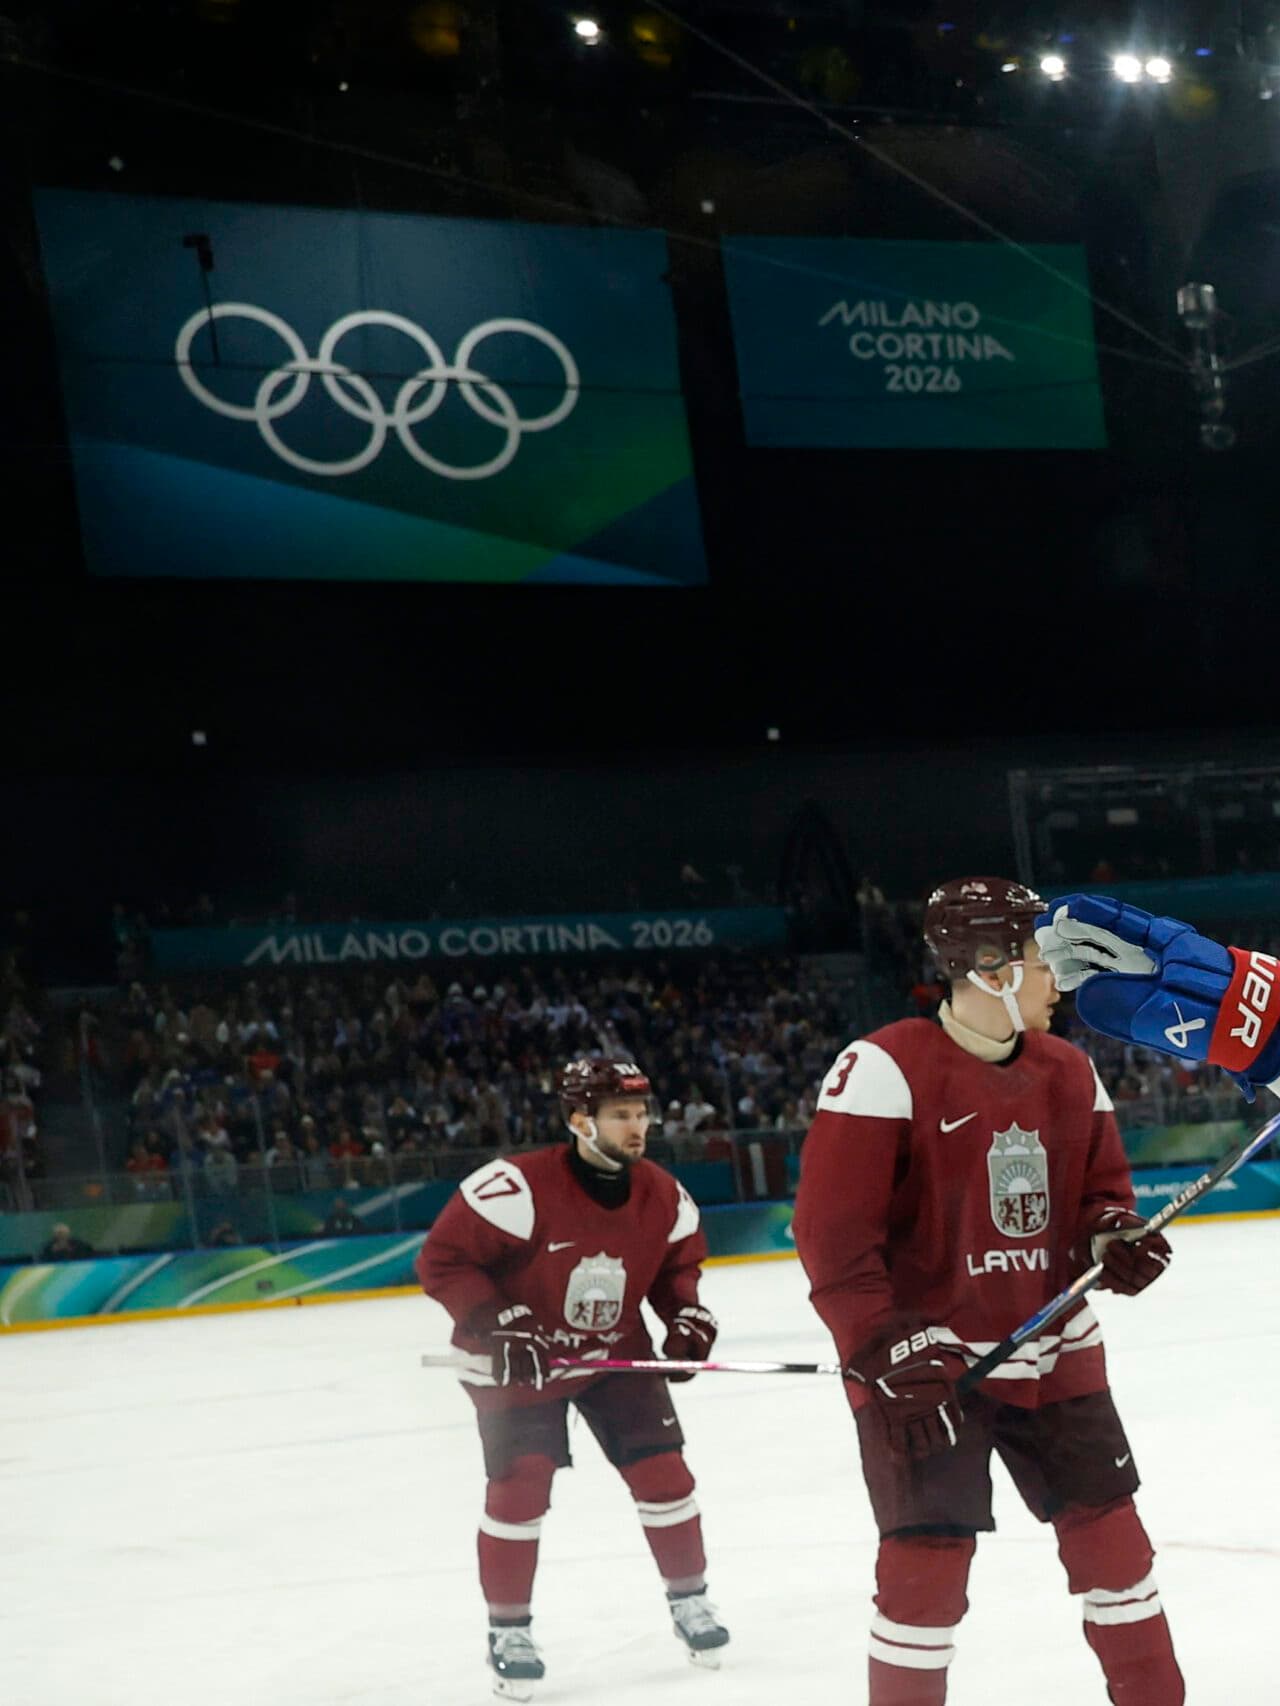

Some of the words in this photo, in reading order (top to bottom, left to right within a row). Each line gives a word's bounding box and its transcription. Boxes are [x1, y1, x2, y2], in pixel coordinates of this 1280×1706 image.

[818, 300, 981, 329] MILANO
[849, 332, 1015, 361] CORTINA
[884, 365, 961, 393] 2026
[244, 927, 430, 967] MILANO
[440, 921, 623, 957] CORTINA
[631, 919, 714, 948] 2026
[826, 1052, 858, 1097] 3
[472, 1171, 522, 1201] 17
[966, 1247, 1049, 1277] LATVI
